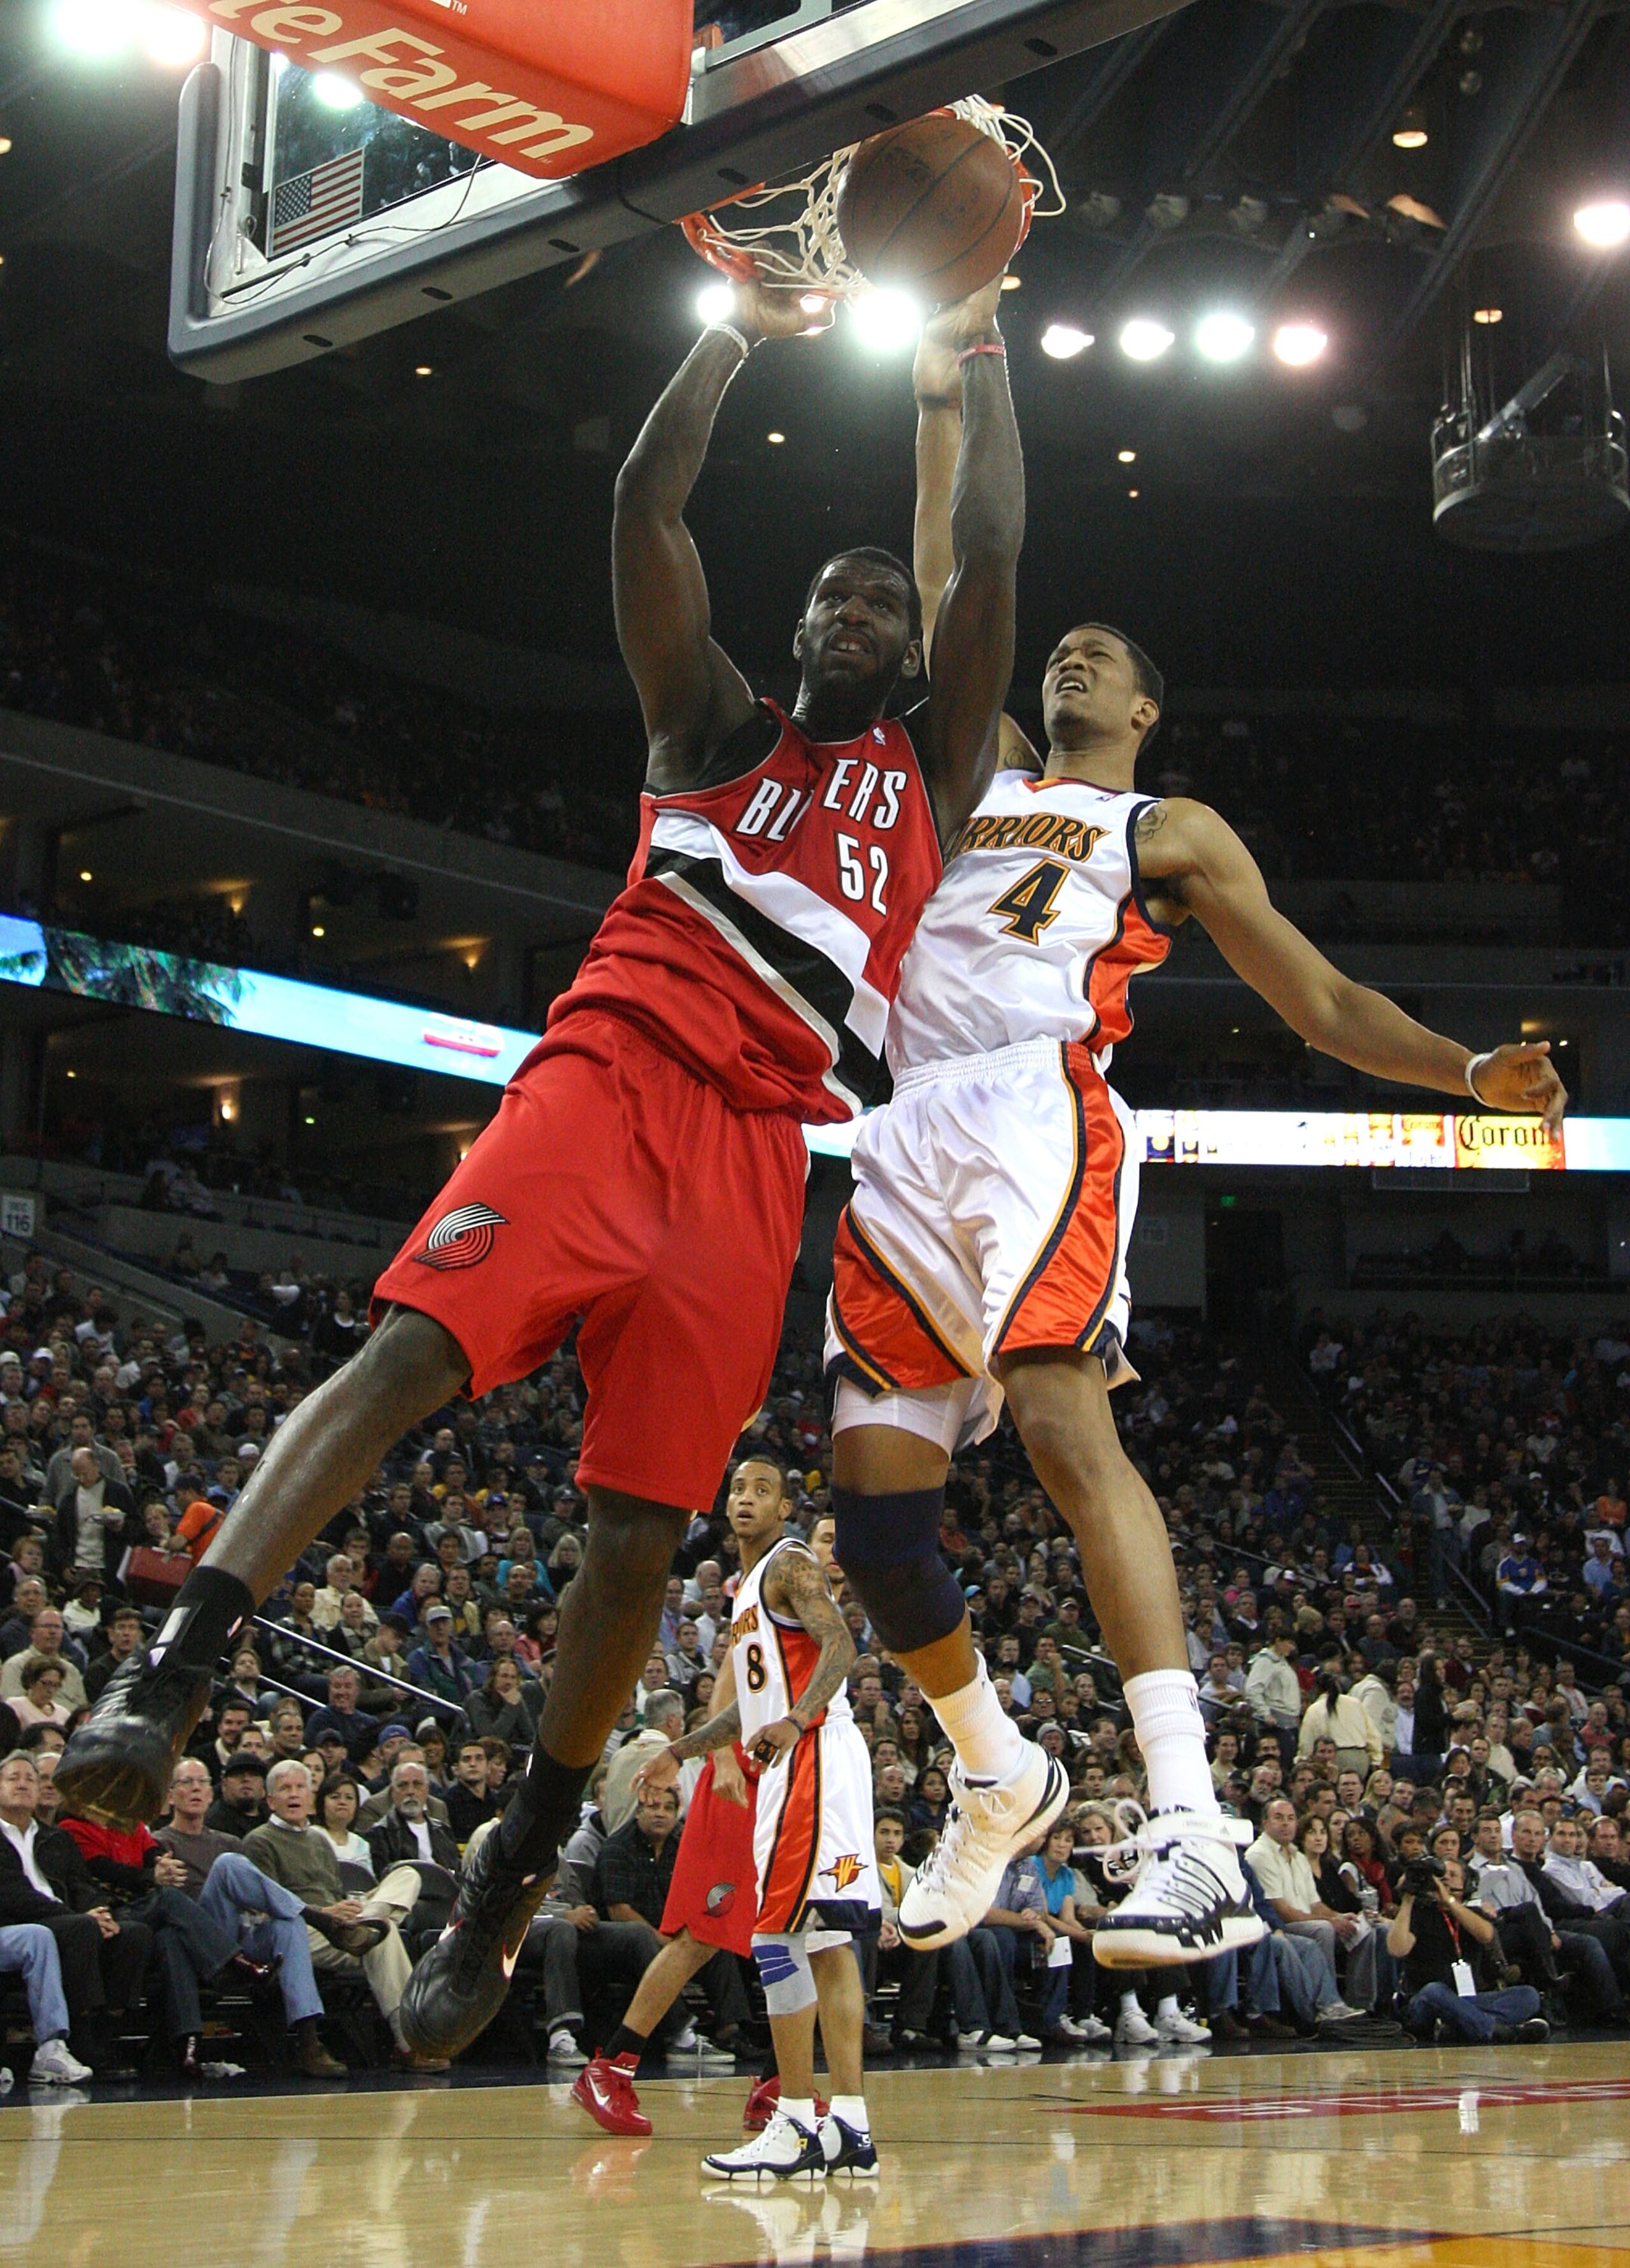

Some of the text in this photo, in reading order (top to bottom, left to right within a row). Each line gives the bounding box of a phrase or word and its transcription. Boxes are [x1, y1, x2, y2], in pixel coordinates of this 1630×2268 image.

[306, 27, 594, 159] Farm
[837, 832, 887, 916] 52
[986, 857, 1072, 946] 4
[1459, 1116, 1548, 1151] Coron
[6, 1214, 31, 1231] 116
[746, 1641, 765, 1693] 8
